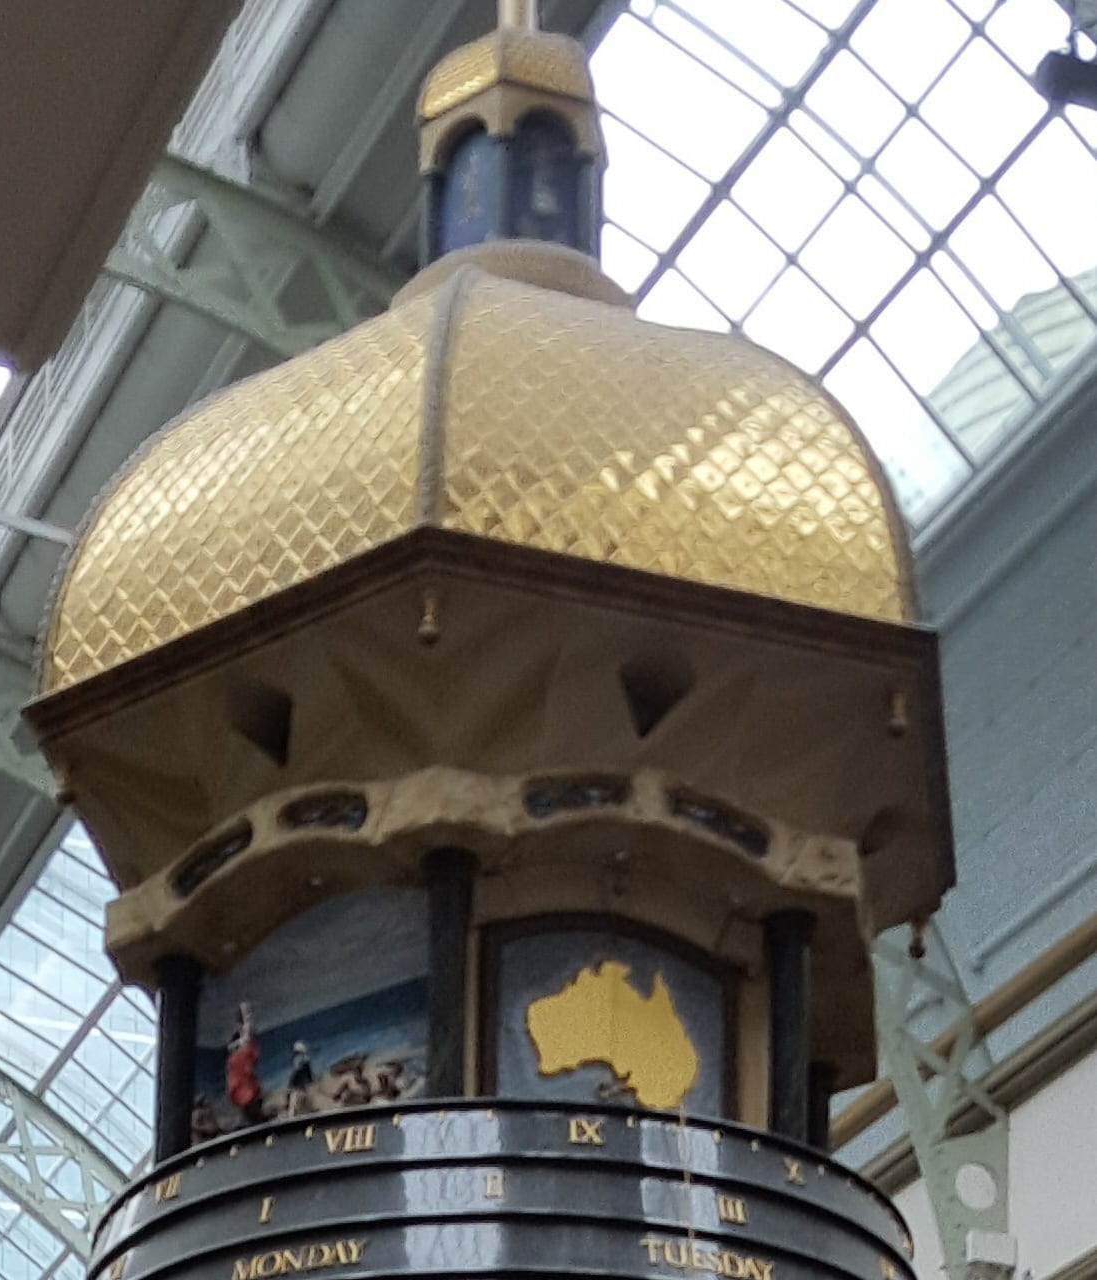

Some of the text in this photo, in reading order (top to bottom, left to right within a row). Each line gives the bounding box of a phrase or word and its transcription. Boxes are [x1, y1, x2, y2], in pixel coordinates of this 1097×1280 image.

[324, 1124, 376, 1153] VIII
[568, 1118, 604, 1145] IX
[784, 1157, 805, 1186] X
[258, 1196, 273, 1223] I
[718, 1194, 748, 1225] III
